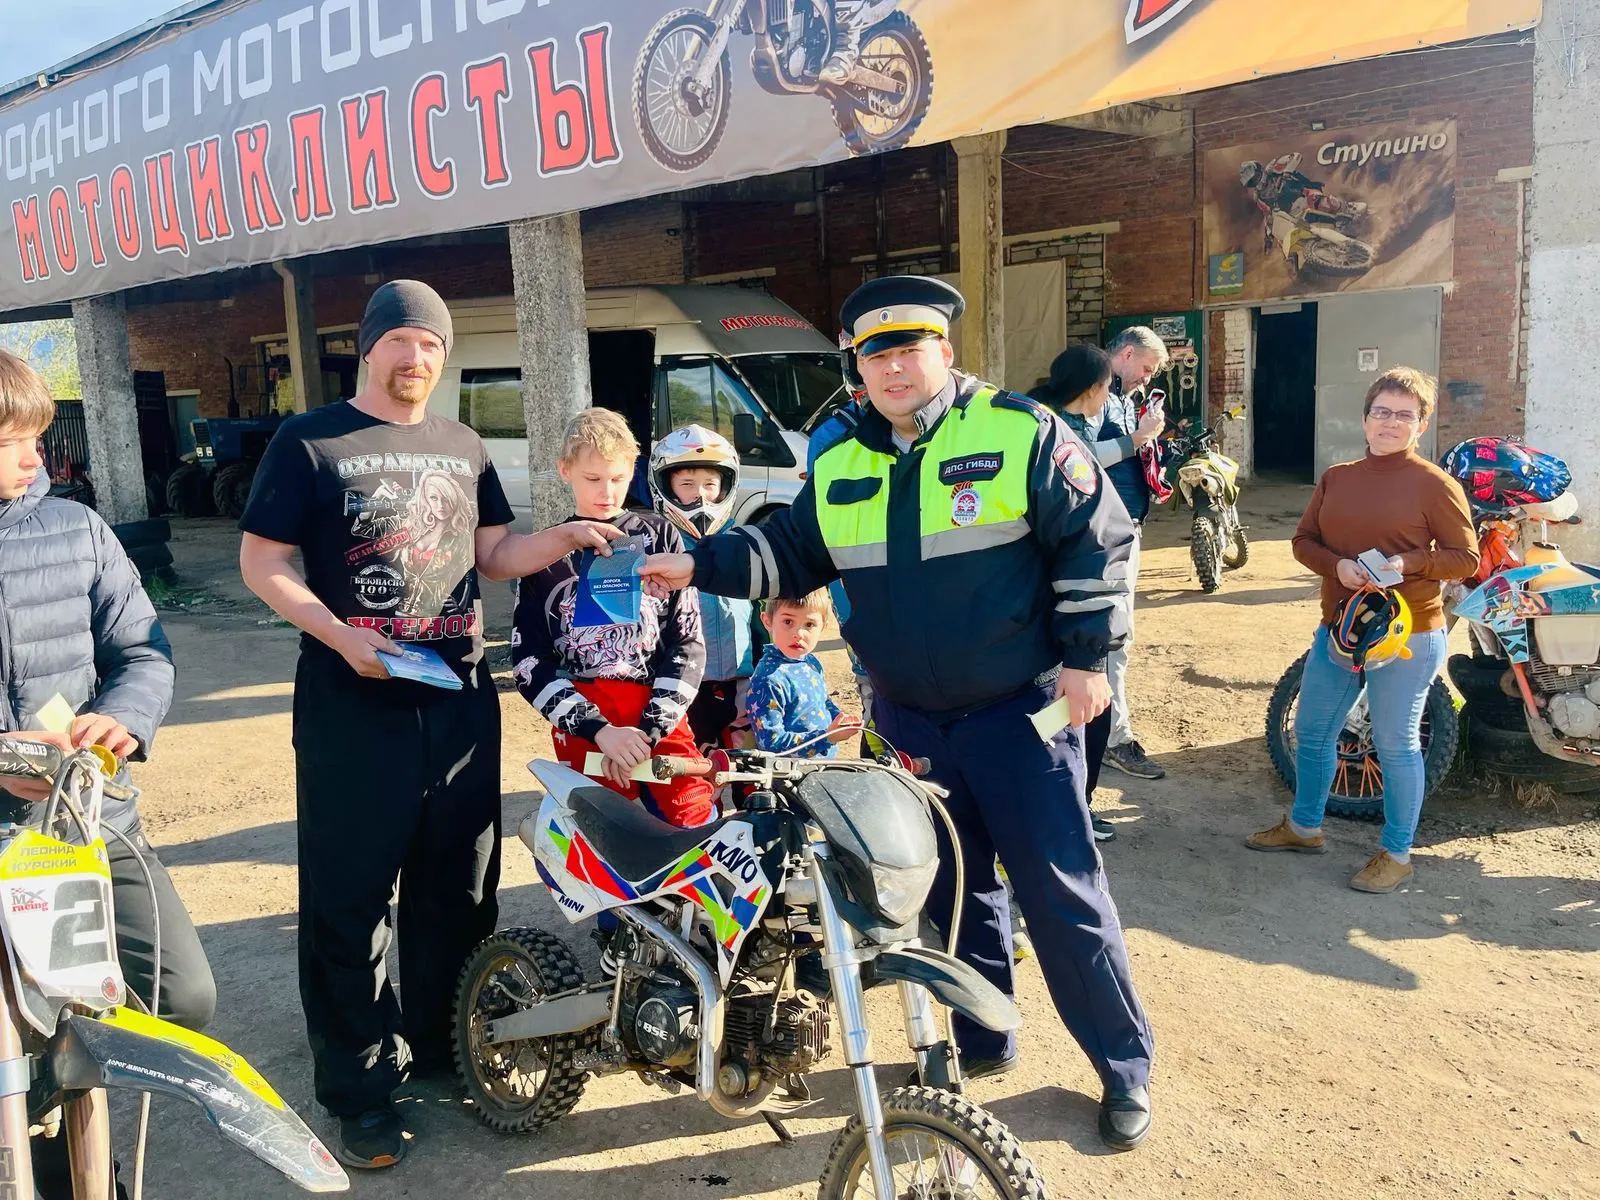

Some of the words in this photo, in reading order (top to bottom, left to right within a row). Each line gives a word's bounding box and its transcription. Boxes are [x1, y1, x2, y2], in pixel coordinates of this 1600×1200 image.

[0, 64, 170, 184] ОДНОГО
[11, 21, 623, 284] МОТОЦИКЛИСТЫ
[1317, 133, 1447, 166] Ступино
[945, 463, 964, 475] ДПС
[966, 460, 998, 469] ГИБДД
[20, 846, 76, 857] ЛЕОНИД
[12, 858, 77, 872] КУРСКИЙ
[12, 901, 49, 913] racing
[558, 894, 585, 914] MINI
[643, 1021, 669, 1041] BSE
